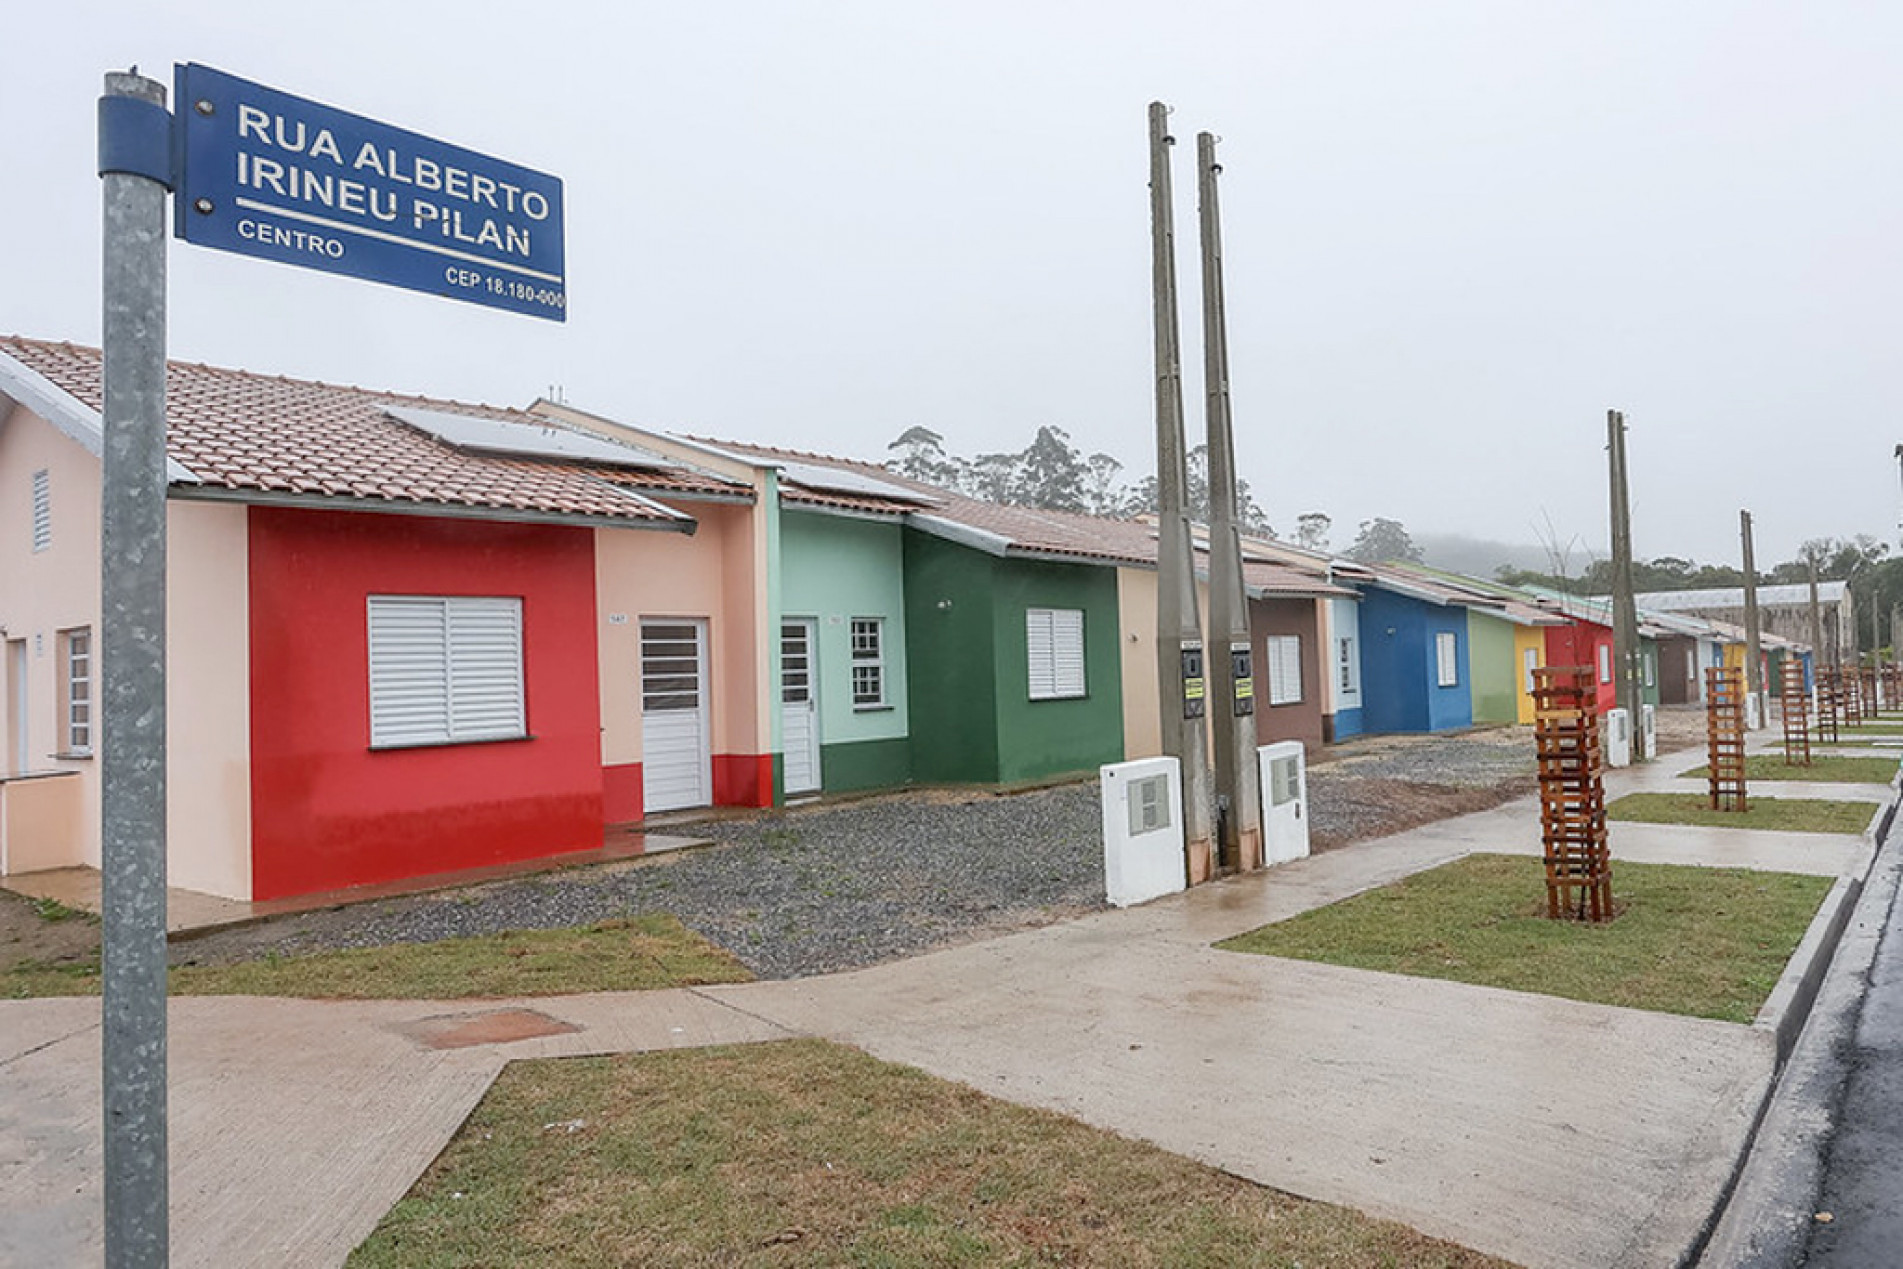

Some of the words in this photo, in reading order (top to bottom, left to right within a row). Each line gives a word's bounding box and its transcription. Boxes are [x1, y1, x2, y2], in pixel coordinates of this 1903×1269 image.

[238, 104, 343, 166] RUA
[353, 142, 550, 221] ALBERTO
[237, 151, 397, 222] IRINEU
[413, 200, 531, 257] PILAN
[237, 220, 345, 259] CENTRO
[445, 266, 481, 288] CEP
